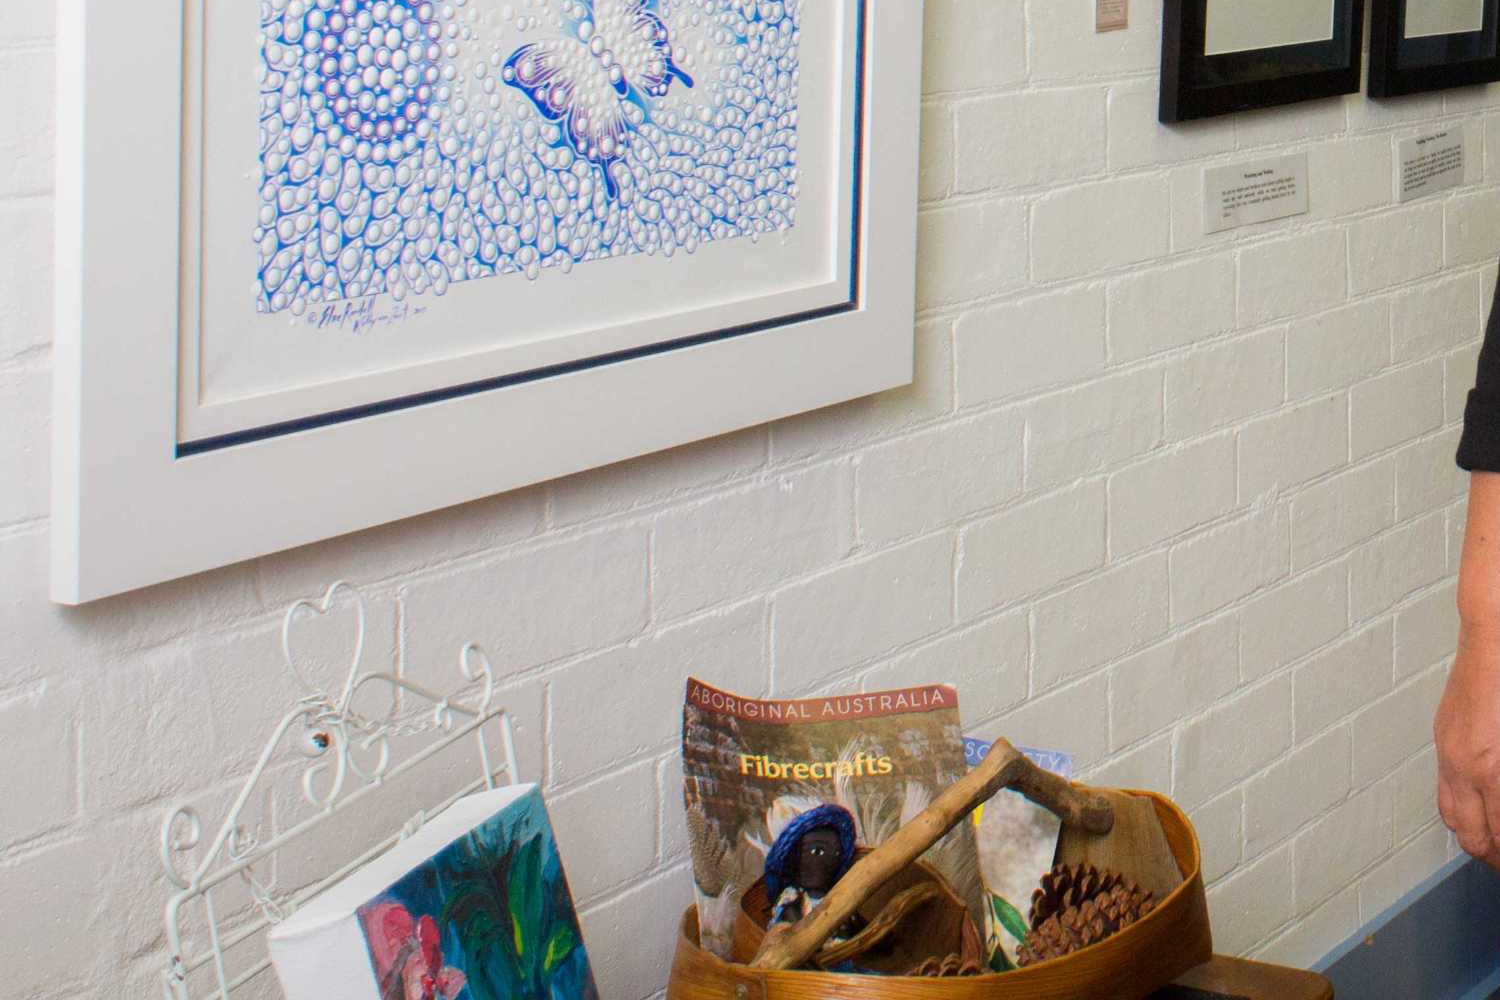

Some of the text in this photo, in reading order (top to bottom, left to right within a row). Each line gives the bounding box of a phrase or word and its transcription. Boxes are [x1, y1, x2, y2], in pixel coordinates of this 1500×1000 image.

[690, 684, 945, 719] ABORIGINAL AUSTRALIA
[739, 752, 893, 779] Fibrecrafts
